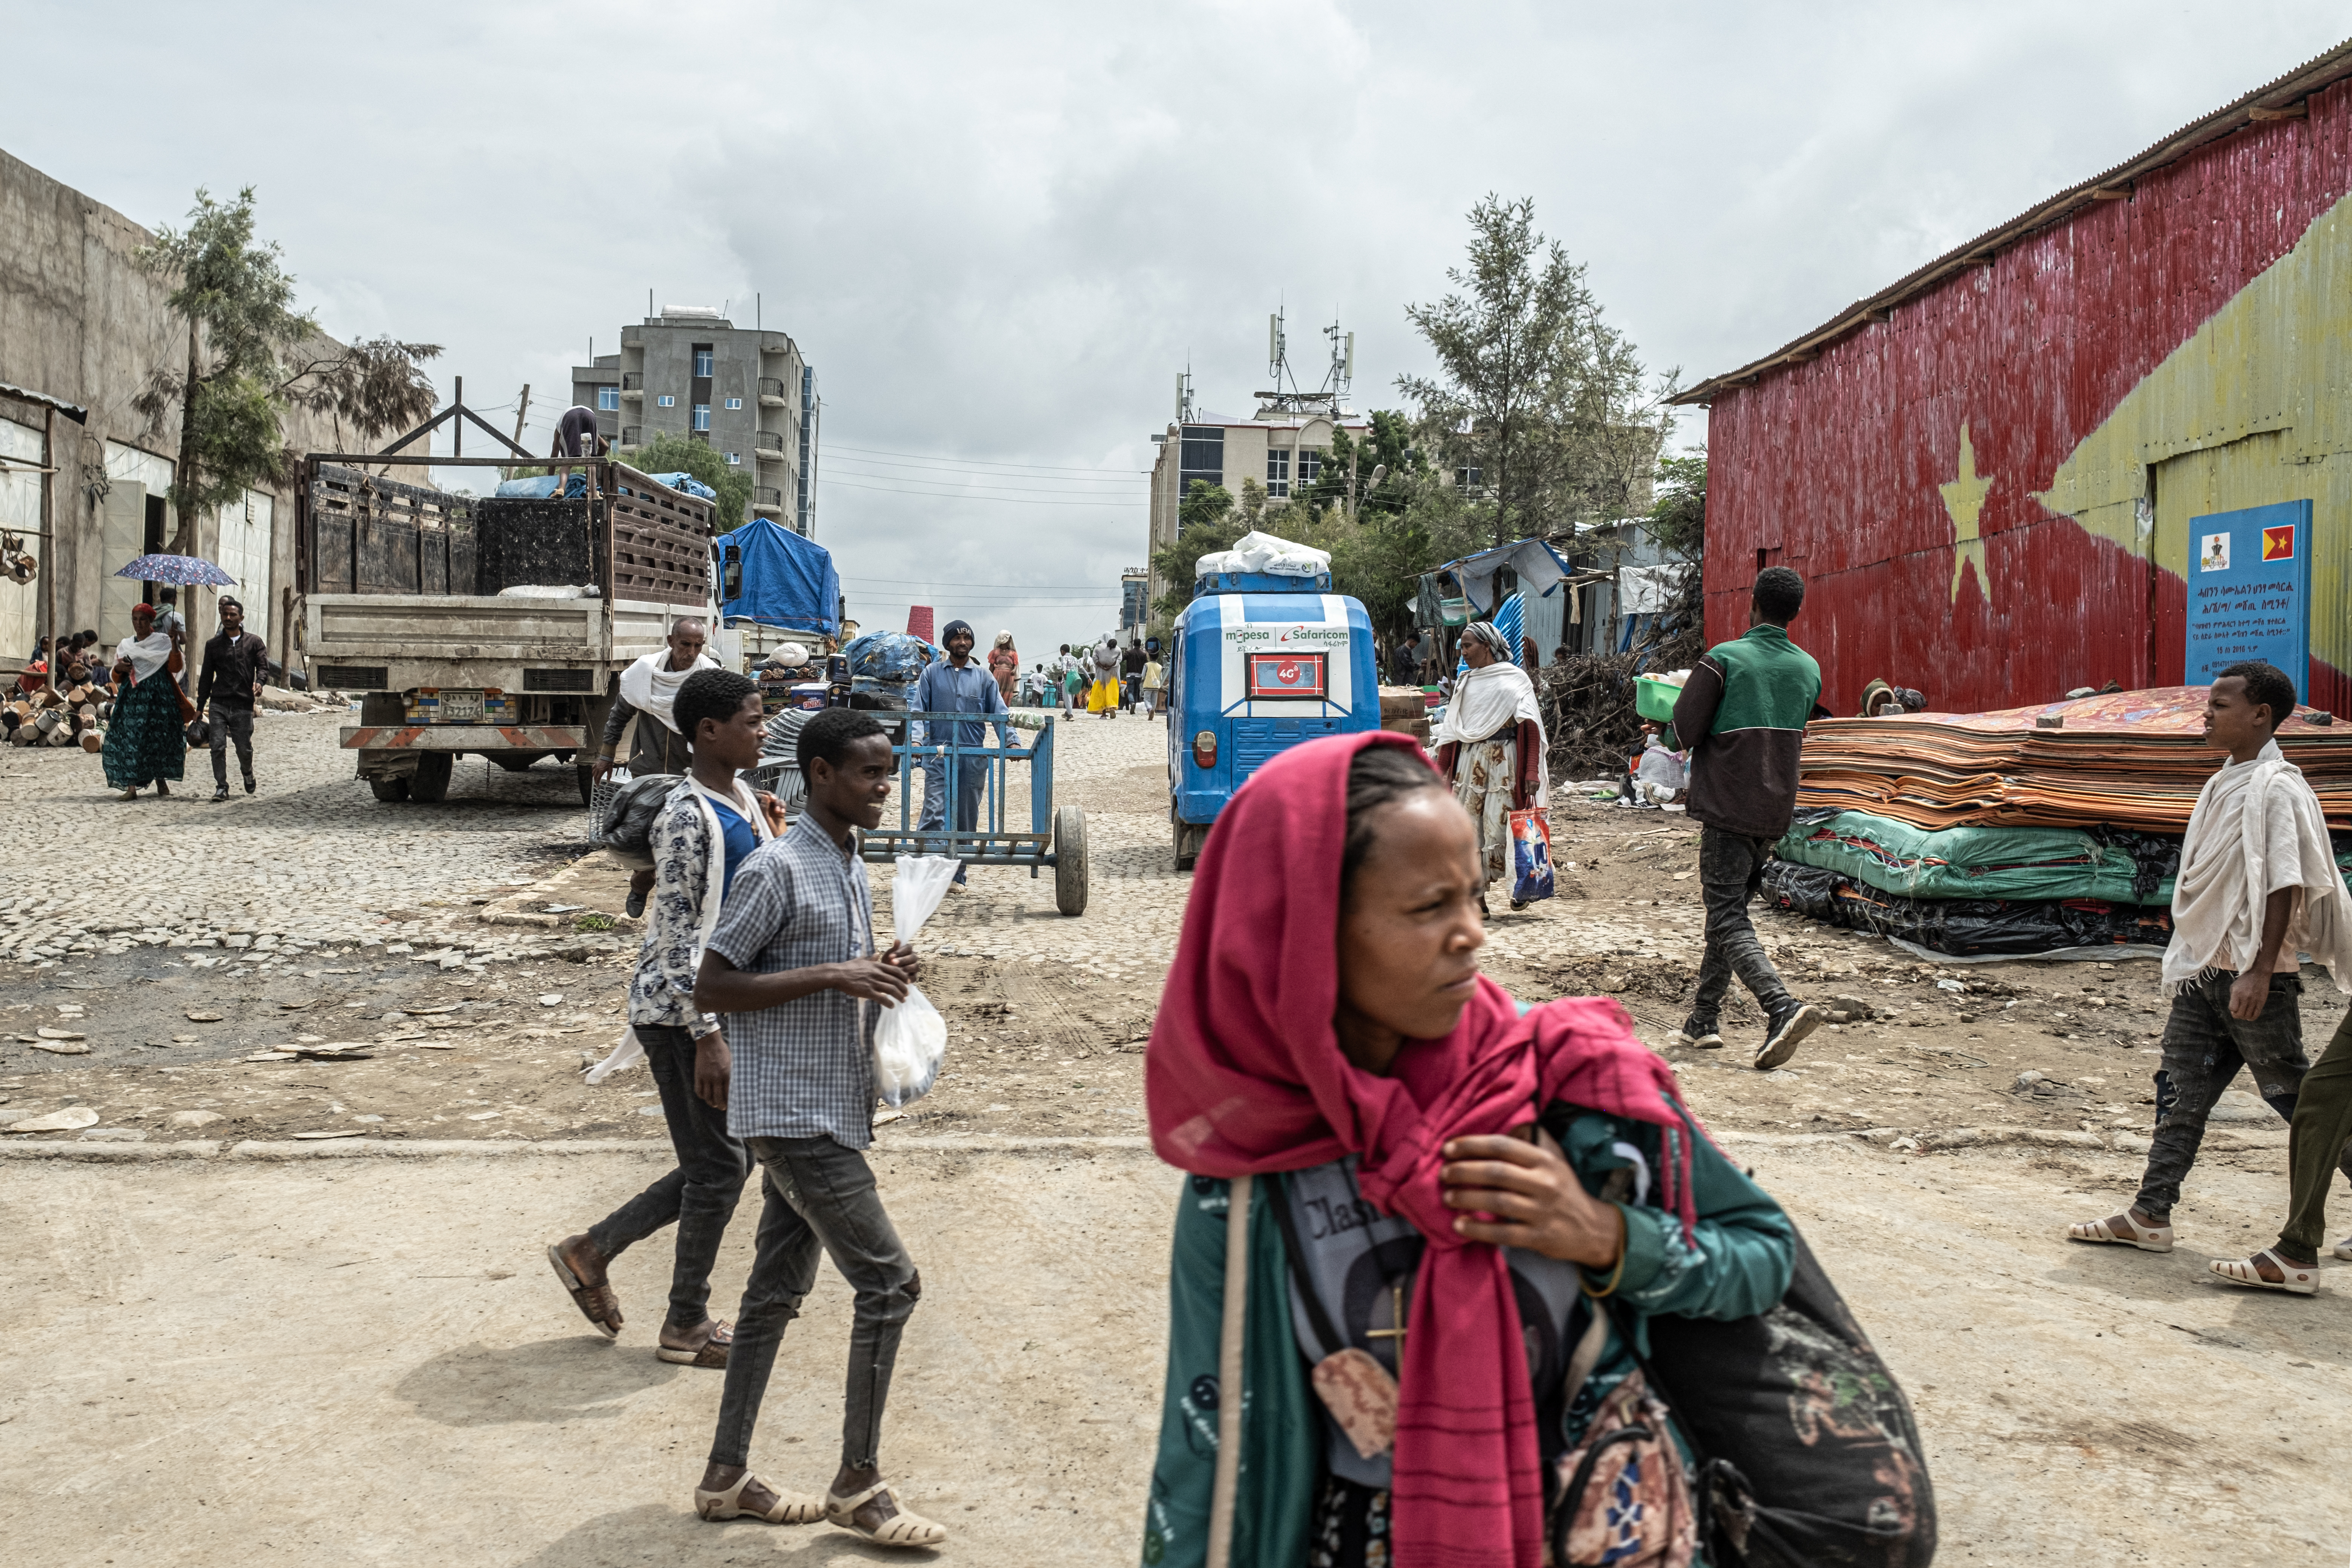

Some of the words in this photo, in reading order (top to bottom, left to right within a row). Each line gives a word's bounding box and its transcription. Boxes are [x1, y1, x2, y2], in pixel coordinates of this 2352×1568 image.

[957, 627, 971, 635] USA
[1292, 630, 1348, 639] Safaricom
[1279, 669, 1294, 678] 4G
[804, 700, 820, 709] KING
